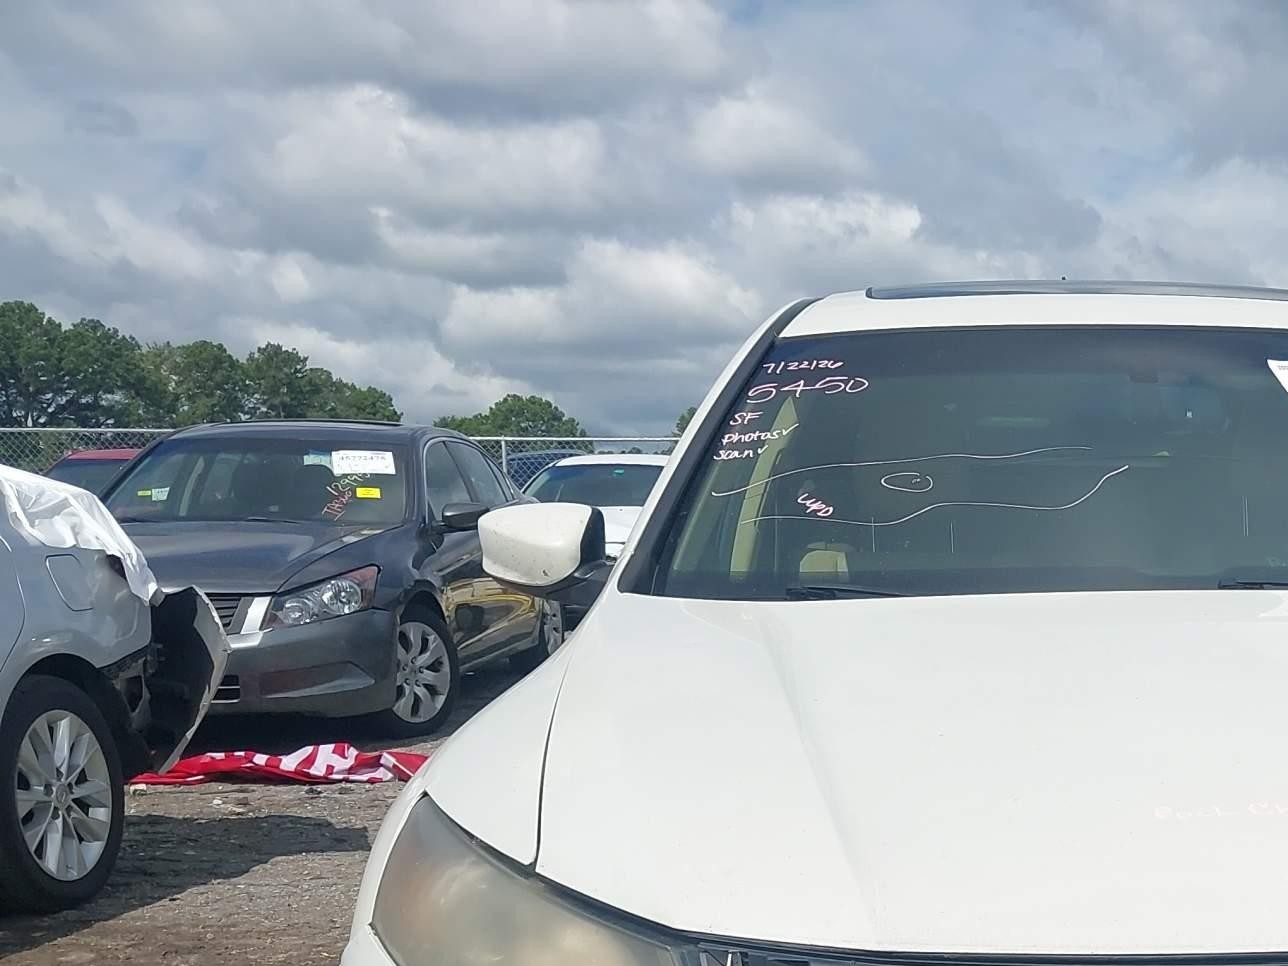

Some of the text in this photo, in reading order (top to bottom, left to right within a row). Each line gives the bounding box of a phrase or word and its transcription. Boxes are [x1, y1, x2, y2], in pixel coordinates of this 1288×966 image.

[763, 360, 844, 374] 7/22/26
[746, 376, 869, 403] 5450
[729, 411, 764, 425] SF
